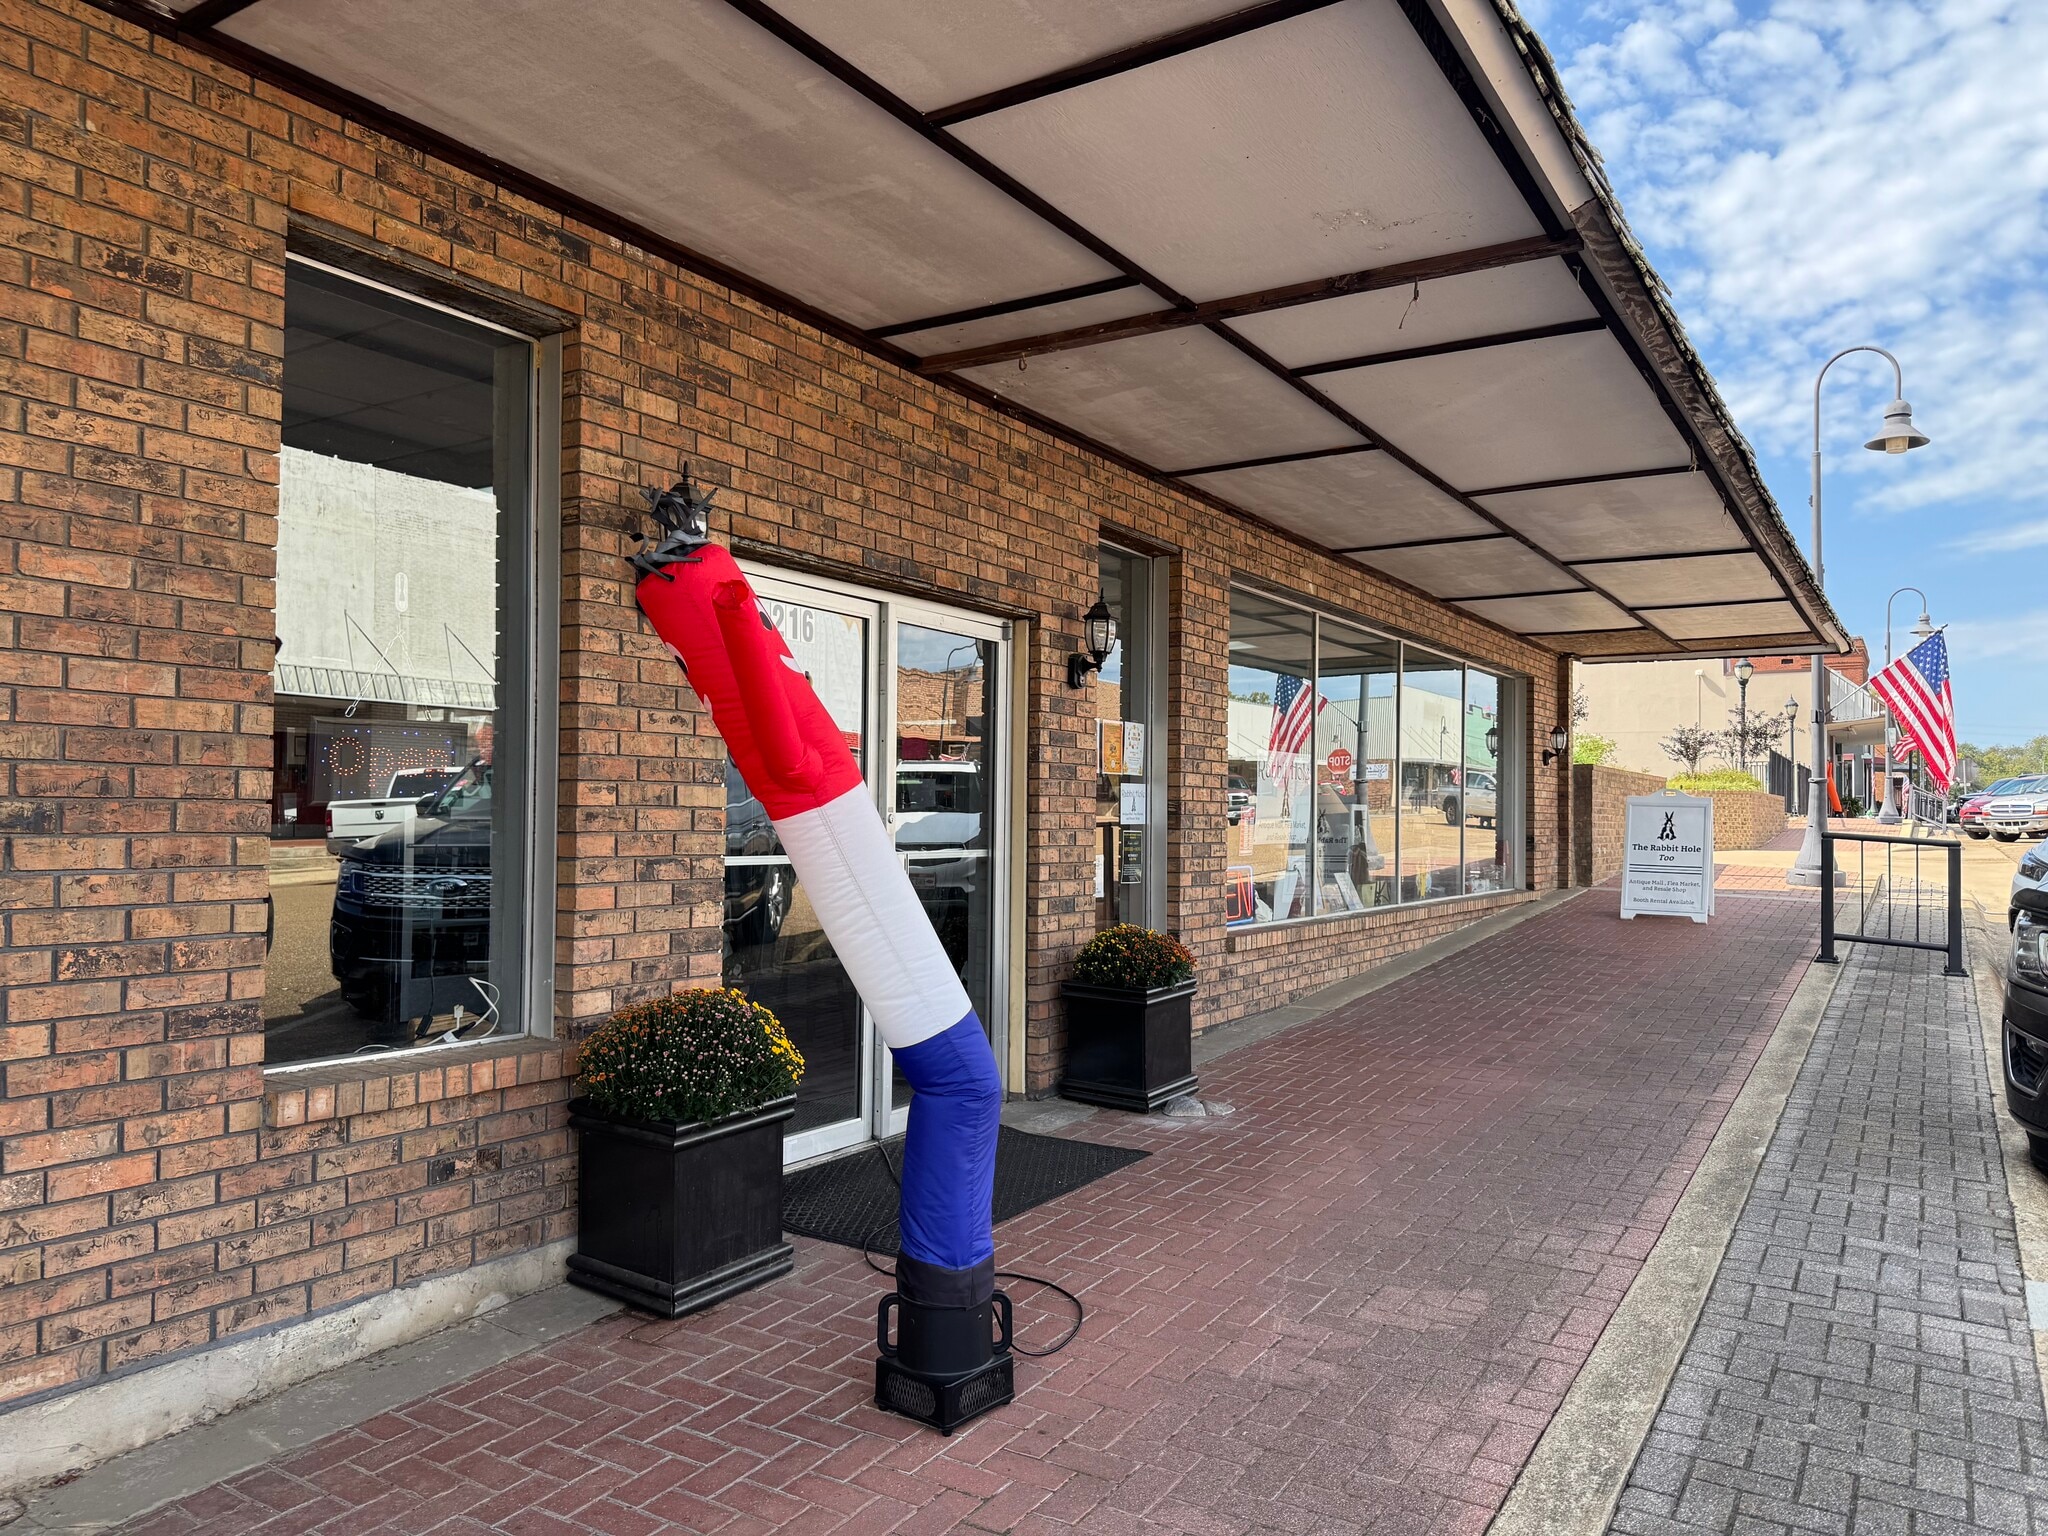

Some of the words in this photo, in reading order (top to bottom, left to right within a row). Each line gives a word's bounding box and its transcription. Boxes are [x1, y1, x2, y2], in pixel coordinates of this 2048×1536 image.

[773, 604, 814, 642] 216
[328, 736, 449, 788] Open
[1632, 843, 1649, 851] The
[1650, 844, 1679, 852] Rabbit
[1681, 845, 1702, 853] Hole
